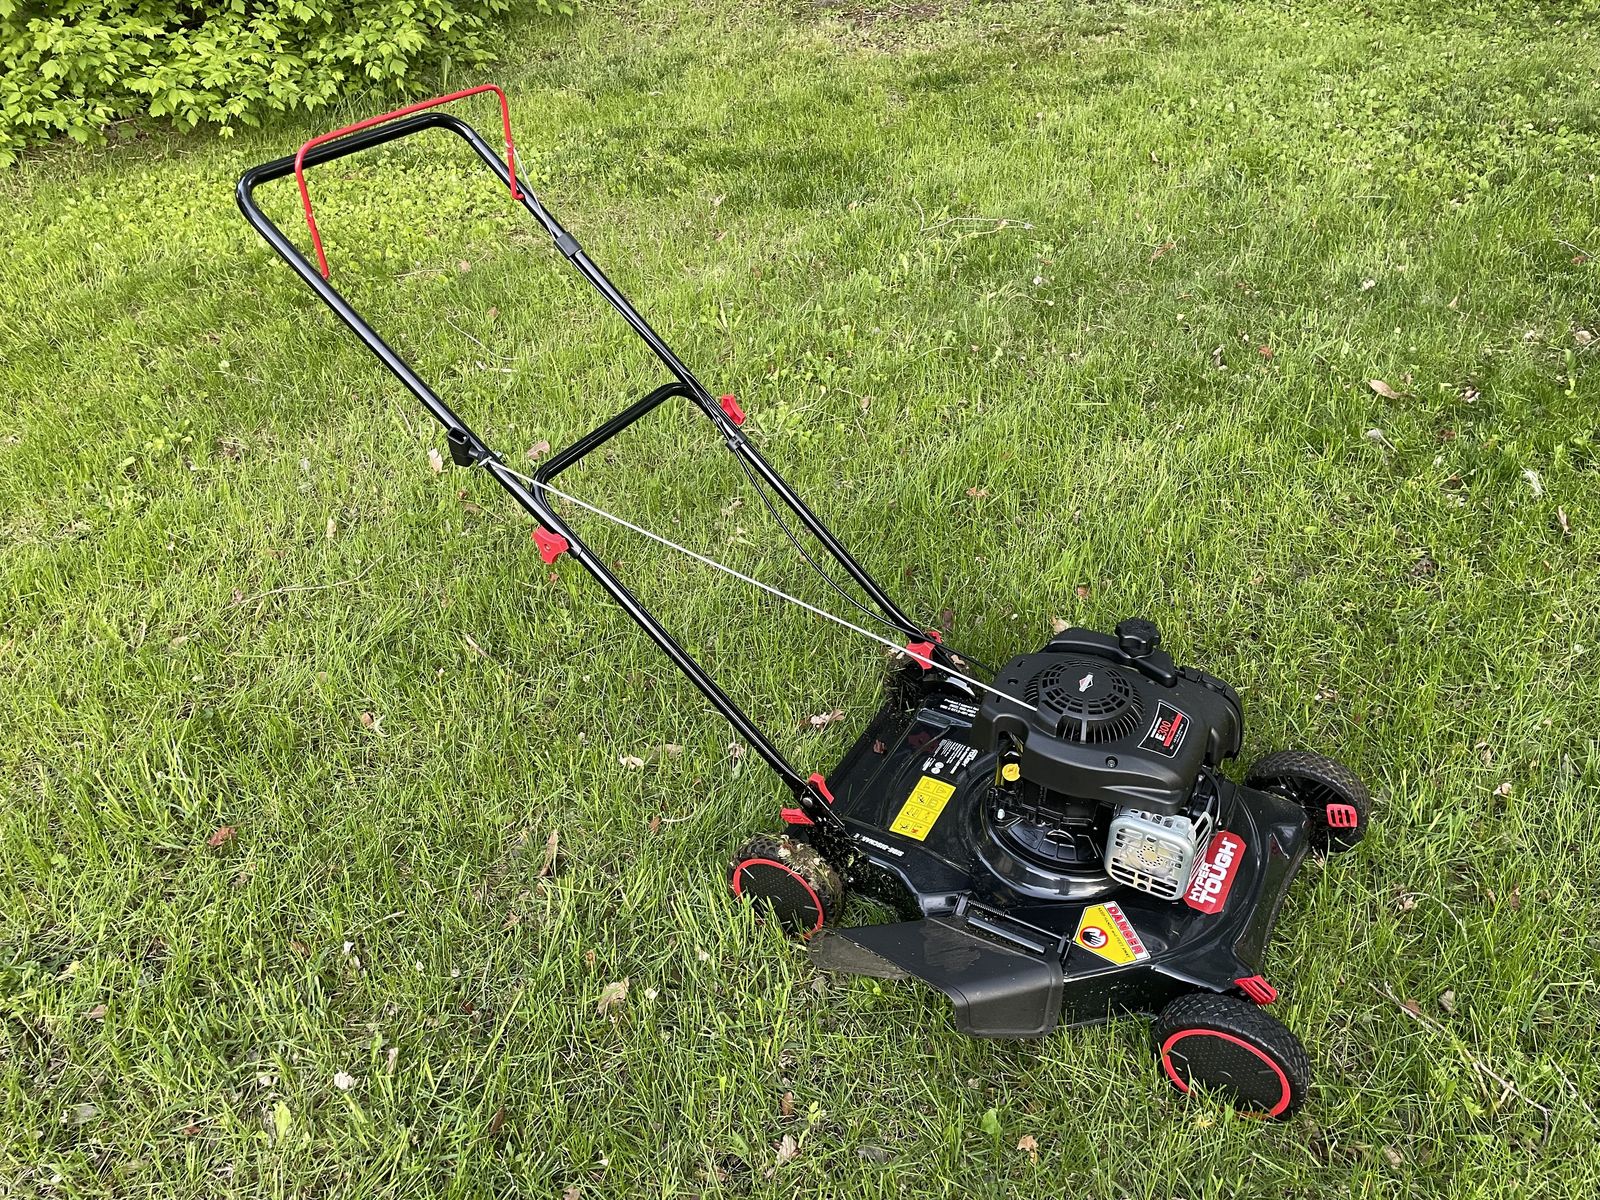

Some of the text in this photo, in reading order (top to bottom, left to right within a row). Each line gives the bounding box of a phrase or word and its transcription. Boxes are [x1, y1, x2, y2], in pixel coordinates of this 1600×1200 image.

[1155, 720, 1172, 742] E300
[1188, 862, 1213, 902] HYPER
[1198, 836, 1238, 904] TOUGH
[1107, 906, 1144, 955] DANGER
